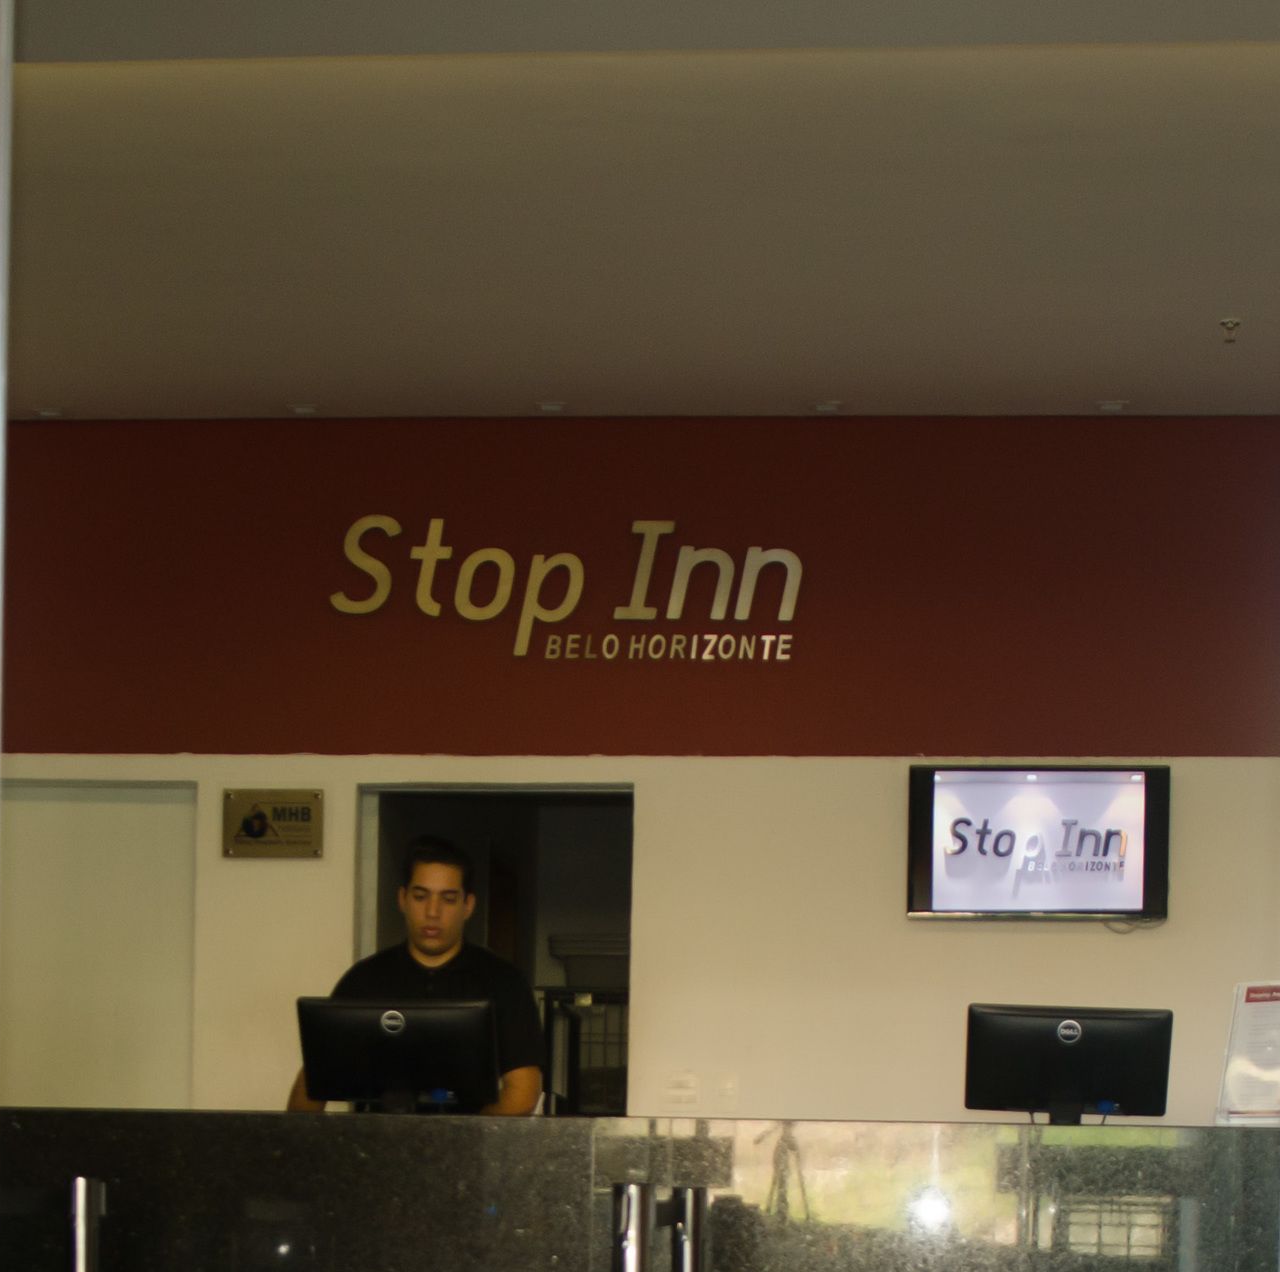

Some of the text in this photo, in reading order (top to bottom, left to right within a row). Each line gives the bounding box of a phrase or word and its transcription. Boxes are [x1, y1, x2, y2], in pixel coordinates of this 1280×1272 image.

[329, 513, 804, 656] Stop Inn
[544, 634, 794, 661] BELO HORIZONTE
[272, 806, 312, 821] MHB
[943, 817, 1129, 871] Stop Inn
